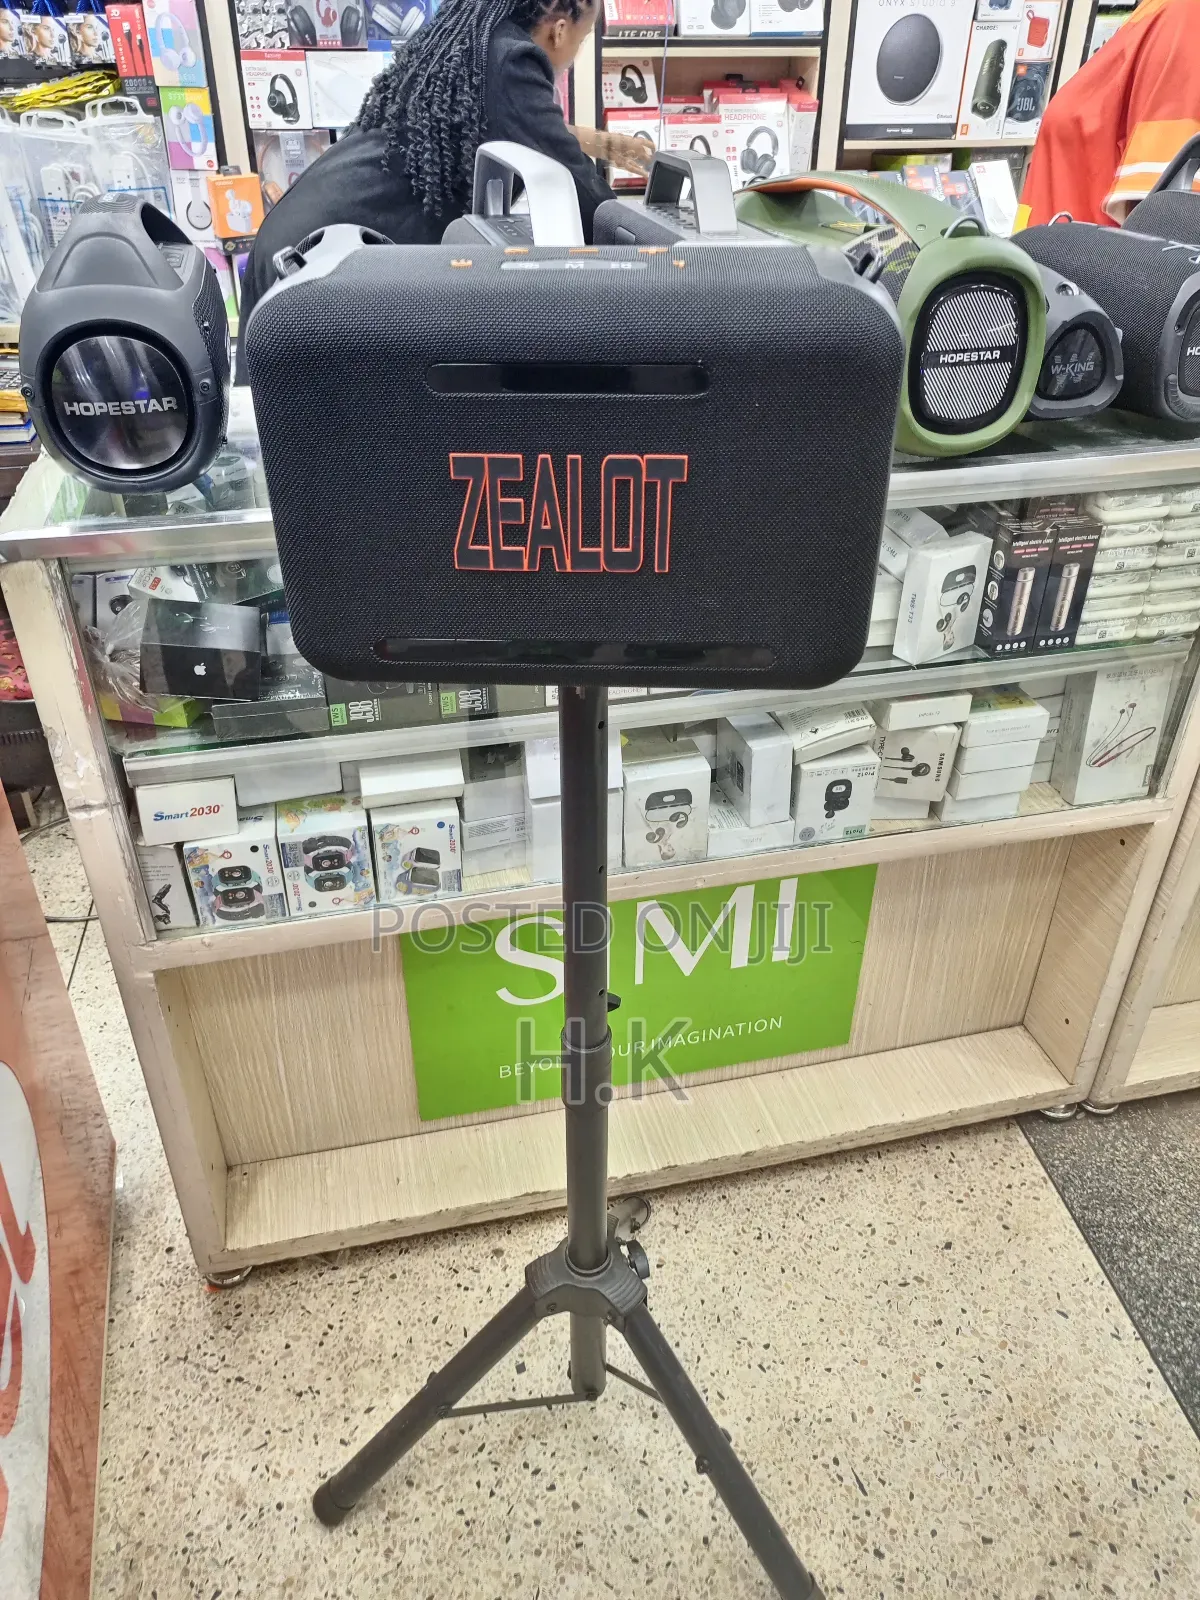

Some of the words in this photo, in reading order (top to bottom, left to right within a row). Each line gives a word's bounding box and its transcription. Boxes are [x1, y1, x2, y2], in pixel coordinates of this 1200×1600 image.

[1017, 97, 1035, 111] JBL
[939, 350, 1001, 364] HOPESTAR
[1051, 361, 1095, 377] W-KING
[63, 396, 178, 417] HOPESTAR
[448, 452, 689, 573] ZEALOT
[441, 695, 450, 714] TWS
[332, 707, 341, 724] TWS
[934, 752, 945, 782] SAMSUNG
[153, 804, 221, 822] Smart2030
[845, 828, 863, 836] Pro12
[651, 1015, 783, 1050] IMAGINATION
